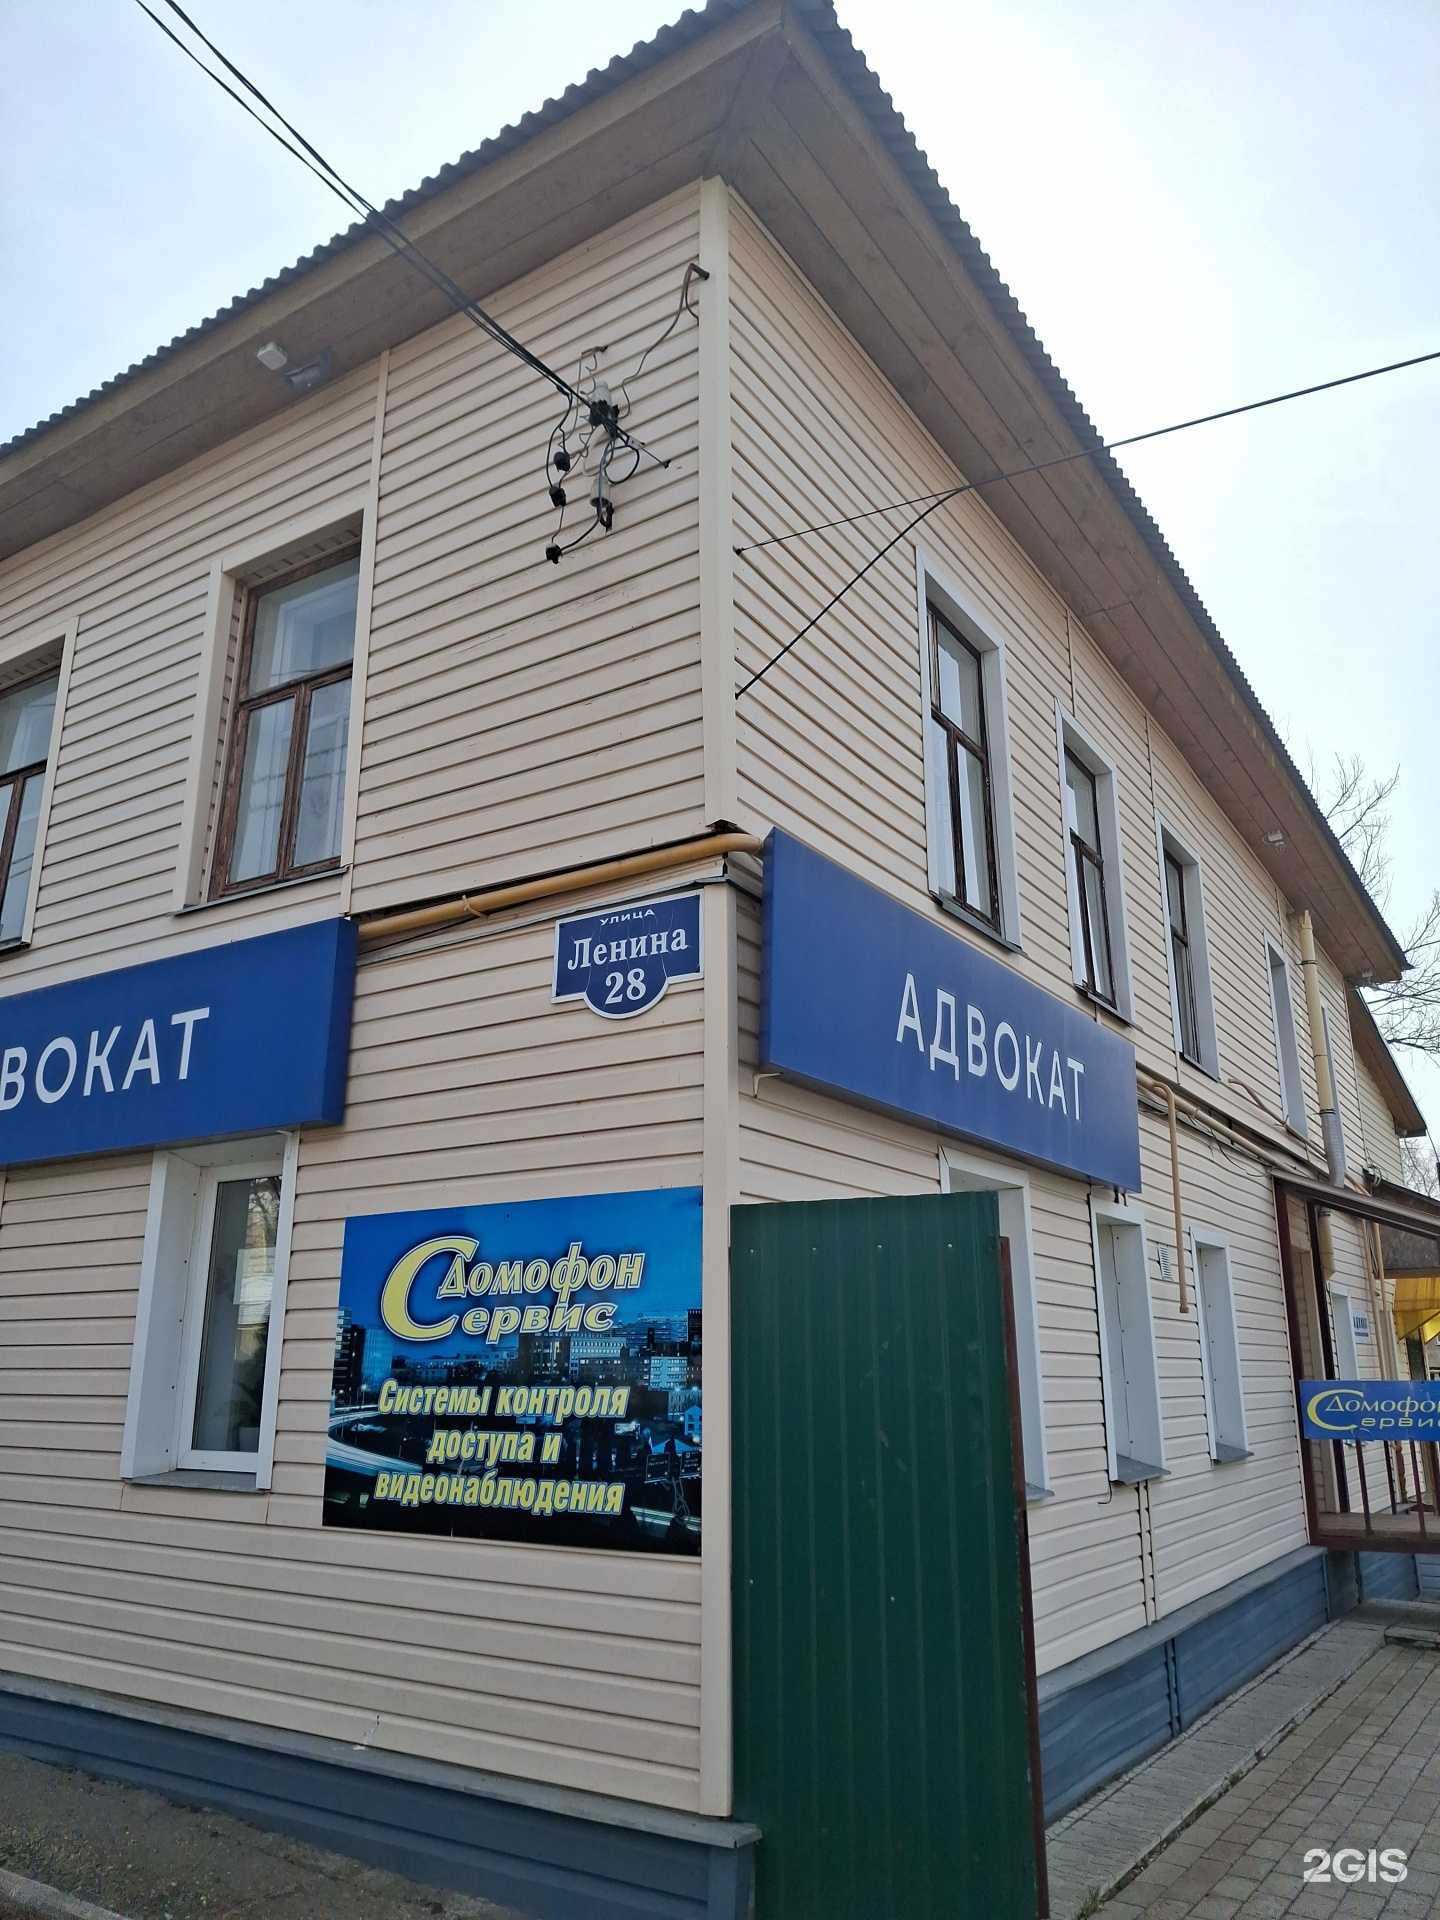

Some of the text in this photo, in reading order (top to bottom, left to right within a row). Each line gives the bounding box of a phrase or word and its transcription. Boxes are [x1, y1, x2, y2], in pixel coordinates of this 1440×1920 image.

[567, 927, 688, 970] Ленина
[604, 967, 647, 1005] 28
[0, 1007, 210, 1111] ВОКАТ
[896, 972, 1085, 1120] АДВОКАТ
[381, 1235, 618, 1344] Сервис
[436, 1241, 645, 1306] Домофон
[378, 1376, 631, 1424] Системы контроля
[1307, 1389, 1440, 1431] Серви
[1325, 1395, 1440, 1417] Домофо
[426, 1429, 562, 1468] доступа и
[373, 1467, 626, 1516] видеонаблюдения
